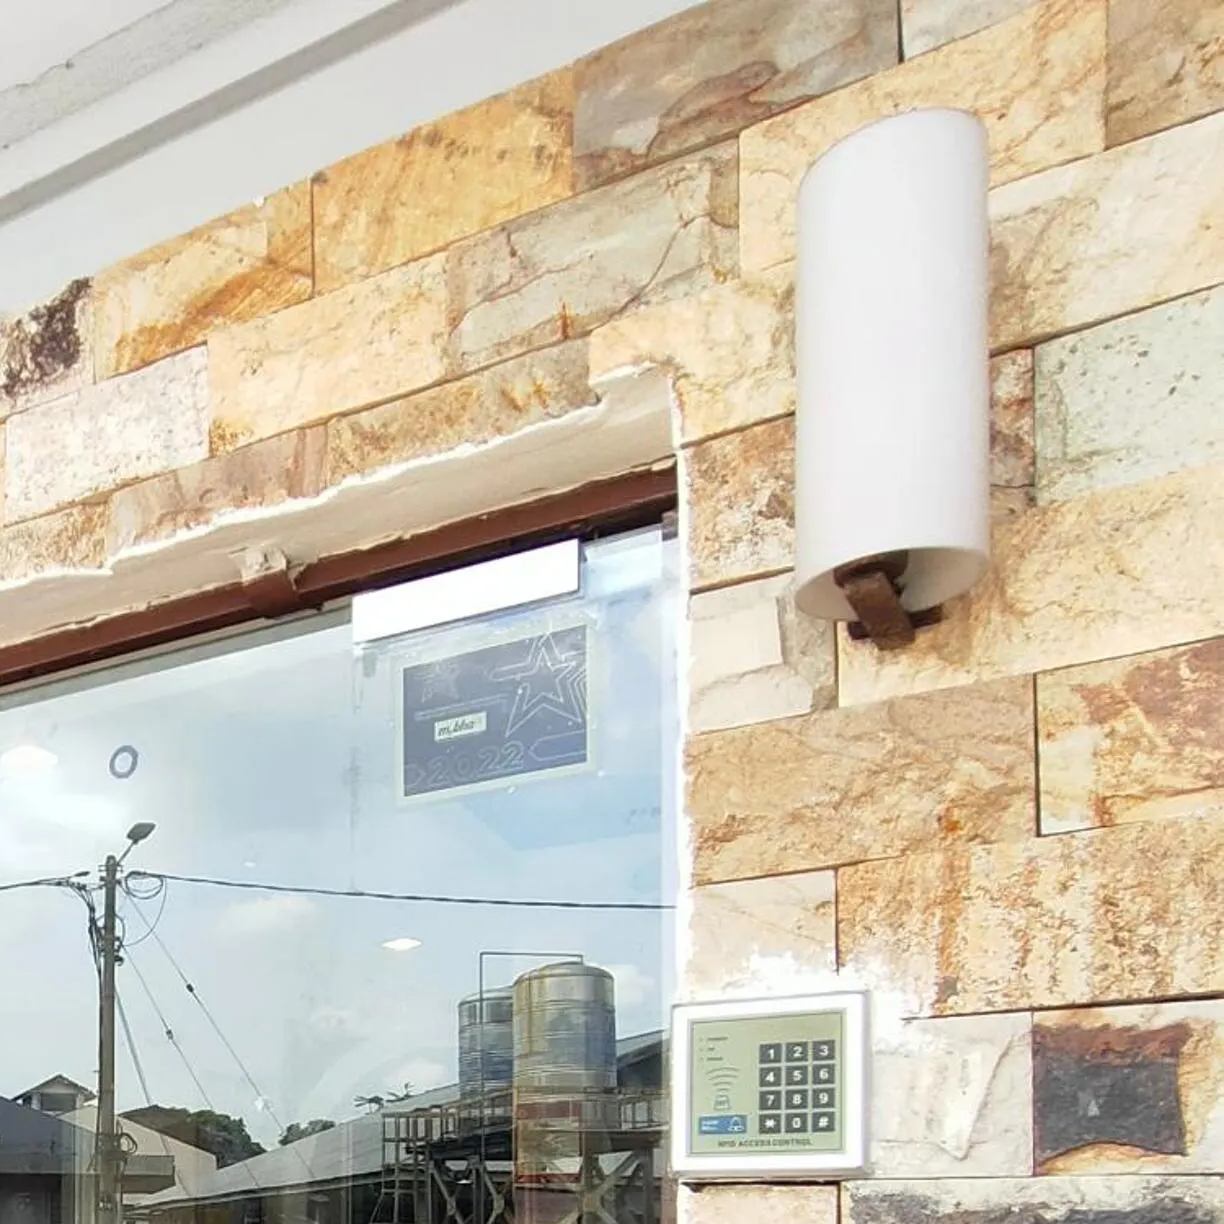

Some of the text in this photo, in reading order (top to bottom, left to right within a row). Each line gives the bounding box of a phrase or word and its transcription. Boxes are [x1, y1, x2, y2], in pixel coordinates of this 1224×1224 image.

[767, 1045, 829, 1059] 1 2 3
[765, 1069, 829, 1082] 4 5 6
[766, 1093, 828, 1105] 7 8 9
